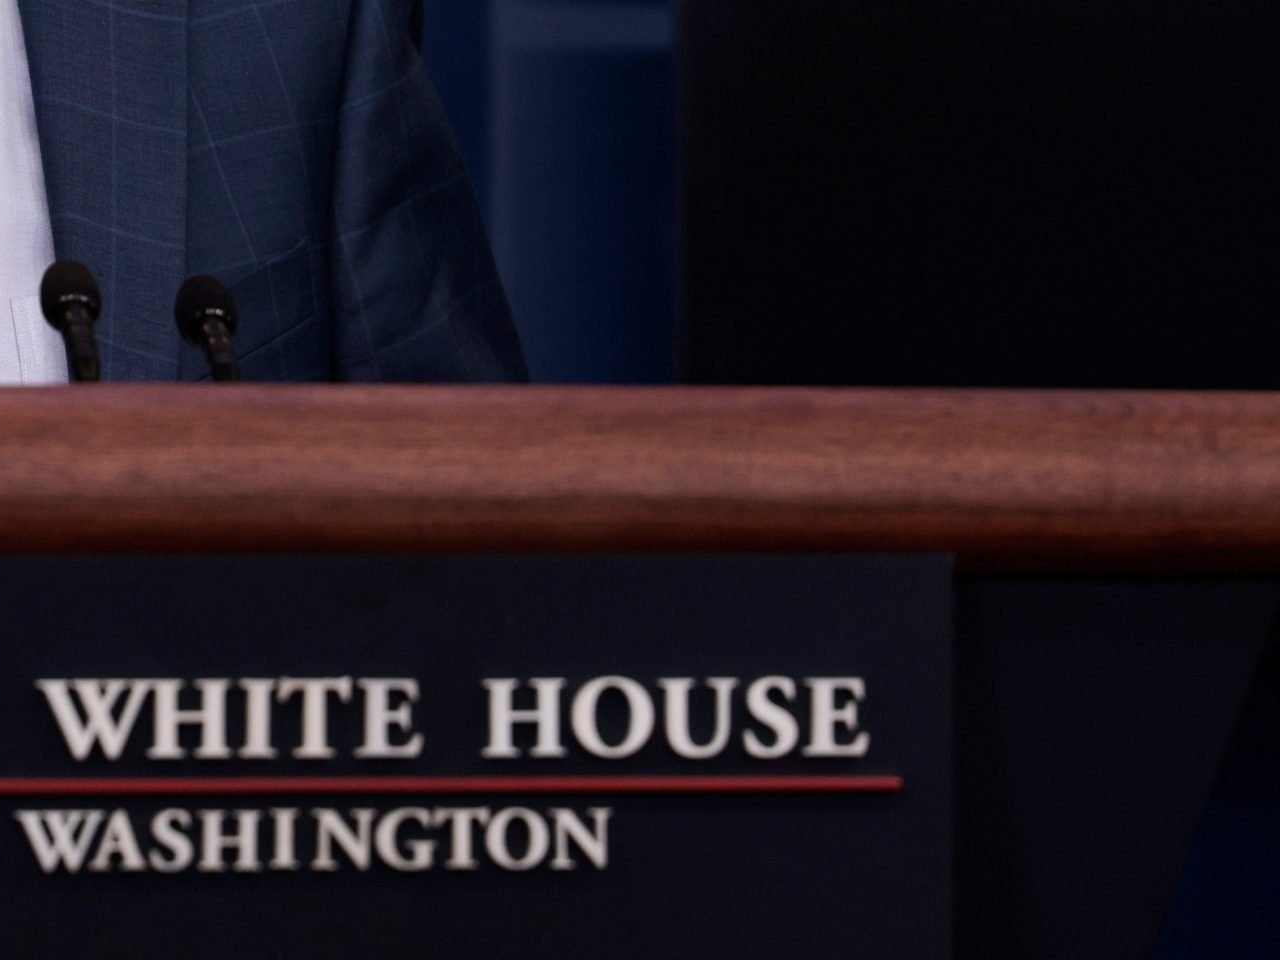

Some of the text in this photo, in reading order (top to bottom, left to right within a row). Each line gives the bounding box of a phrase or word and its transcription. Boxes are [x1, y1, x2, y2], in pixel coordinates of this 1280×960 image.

[35, 676, 424, 761] WHITE
[481, 674, 870, 759] HOUSE
[14, 806, 611, 873] WASHINGTON
